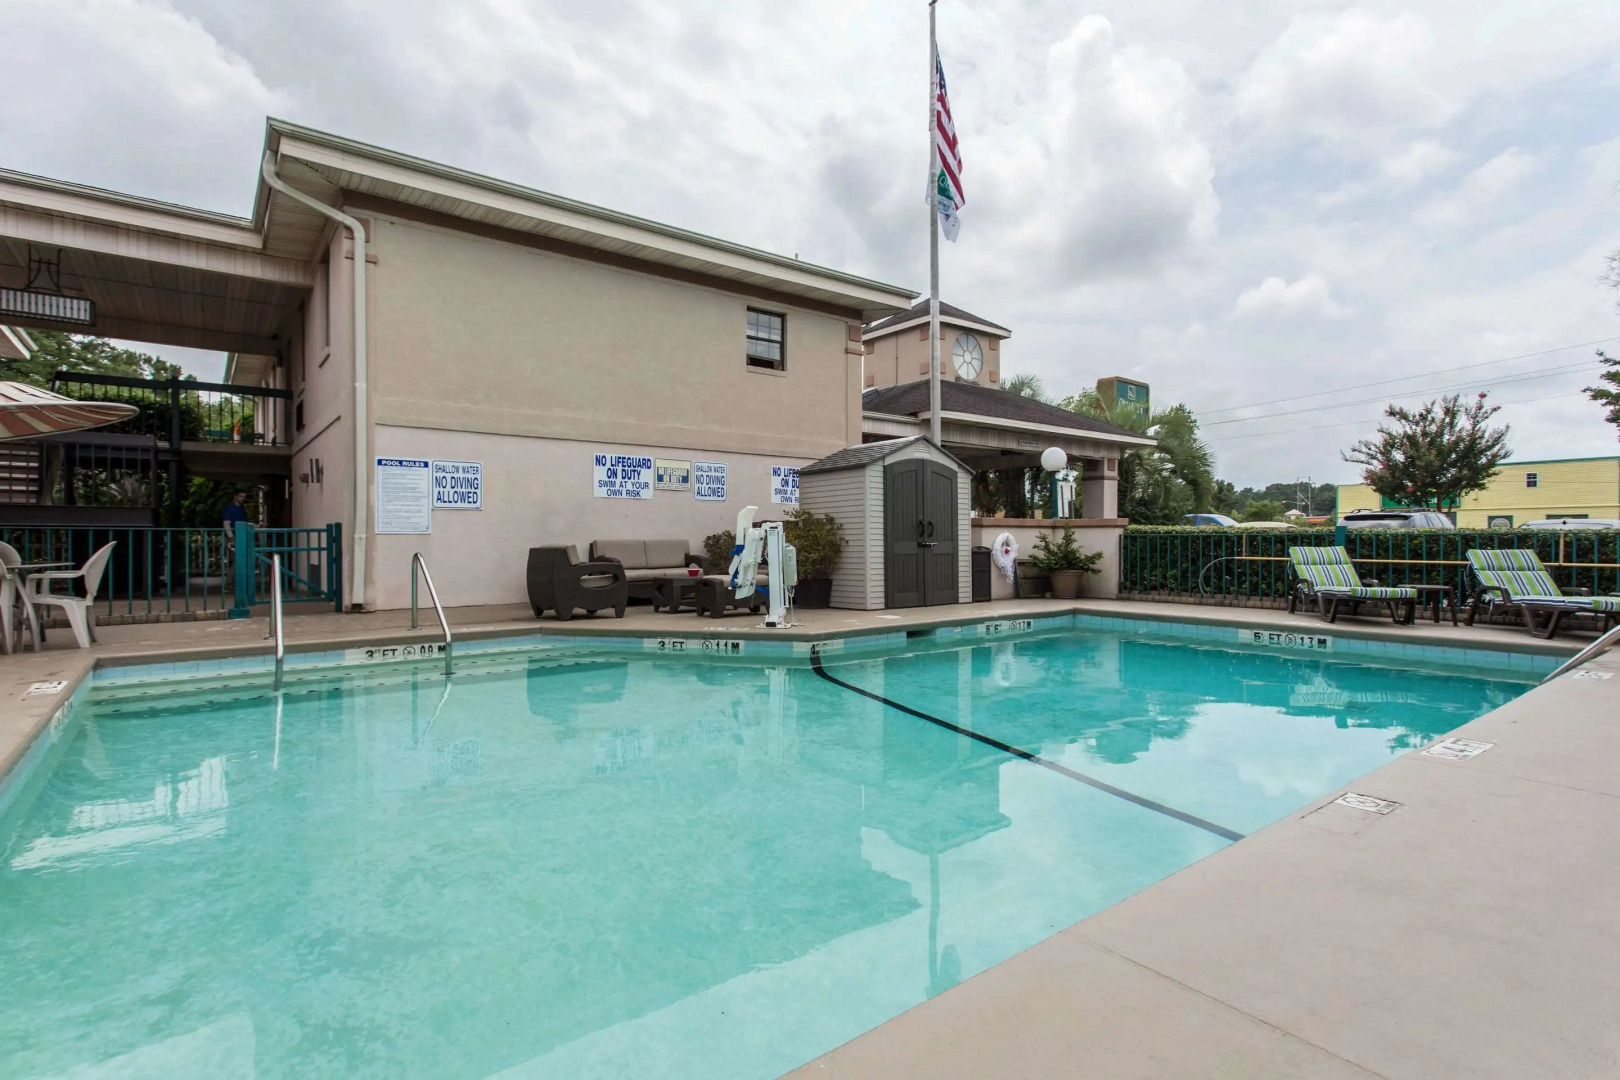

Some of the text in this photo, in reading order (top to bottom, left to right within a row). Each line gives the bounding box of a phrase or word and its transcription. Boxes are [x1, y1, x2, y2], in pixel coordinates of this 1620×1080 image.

[595, 455, 652, 469] NO LIFEGUARD
[435, 464, 480, 475] SHALLOW WATER
[606, 467, 641, 481] ON DUTY
[695, 464, 726, 474] SHALLOW WATER
[772, 466, 782, 477] NO
[435, 475, 479, 490] NO DIVING
[598, 479, 617, 489] SWIM
[618, 480, 628, 489] AT
[631, 481, 650, 490] YOUR
[695, 474, 705, 485] NO
[705, 475, 726, 486] DIVING
[780, 477, 790, 488] ON
[436, 490, 479, 504] ALLOWED
[606, 488, 641, 498] OWN RISK
[696, 486, 725, 498] ALLOWED
[789, 489, 797, 497] AT
[780, 495, 793, 504] OWN
[382, 648, 398, 657] FT
